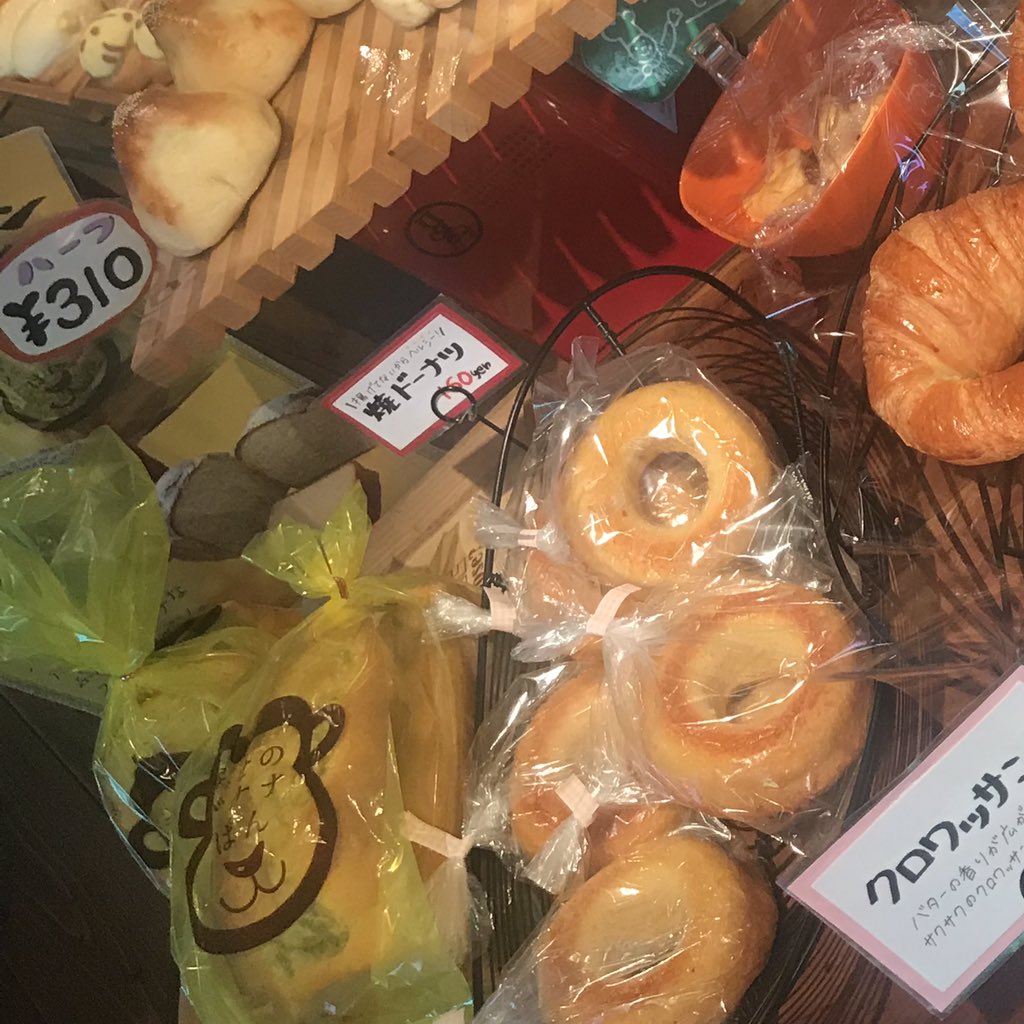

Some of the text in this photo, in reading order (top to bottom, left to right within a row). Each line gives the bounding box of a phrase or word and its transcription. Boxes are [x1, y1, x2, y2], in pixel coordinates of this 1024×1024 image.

[2, 246, 144, 347] ¥310
[362, 342, 465, 423] 焼ドーナツ
